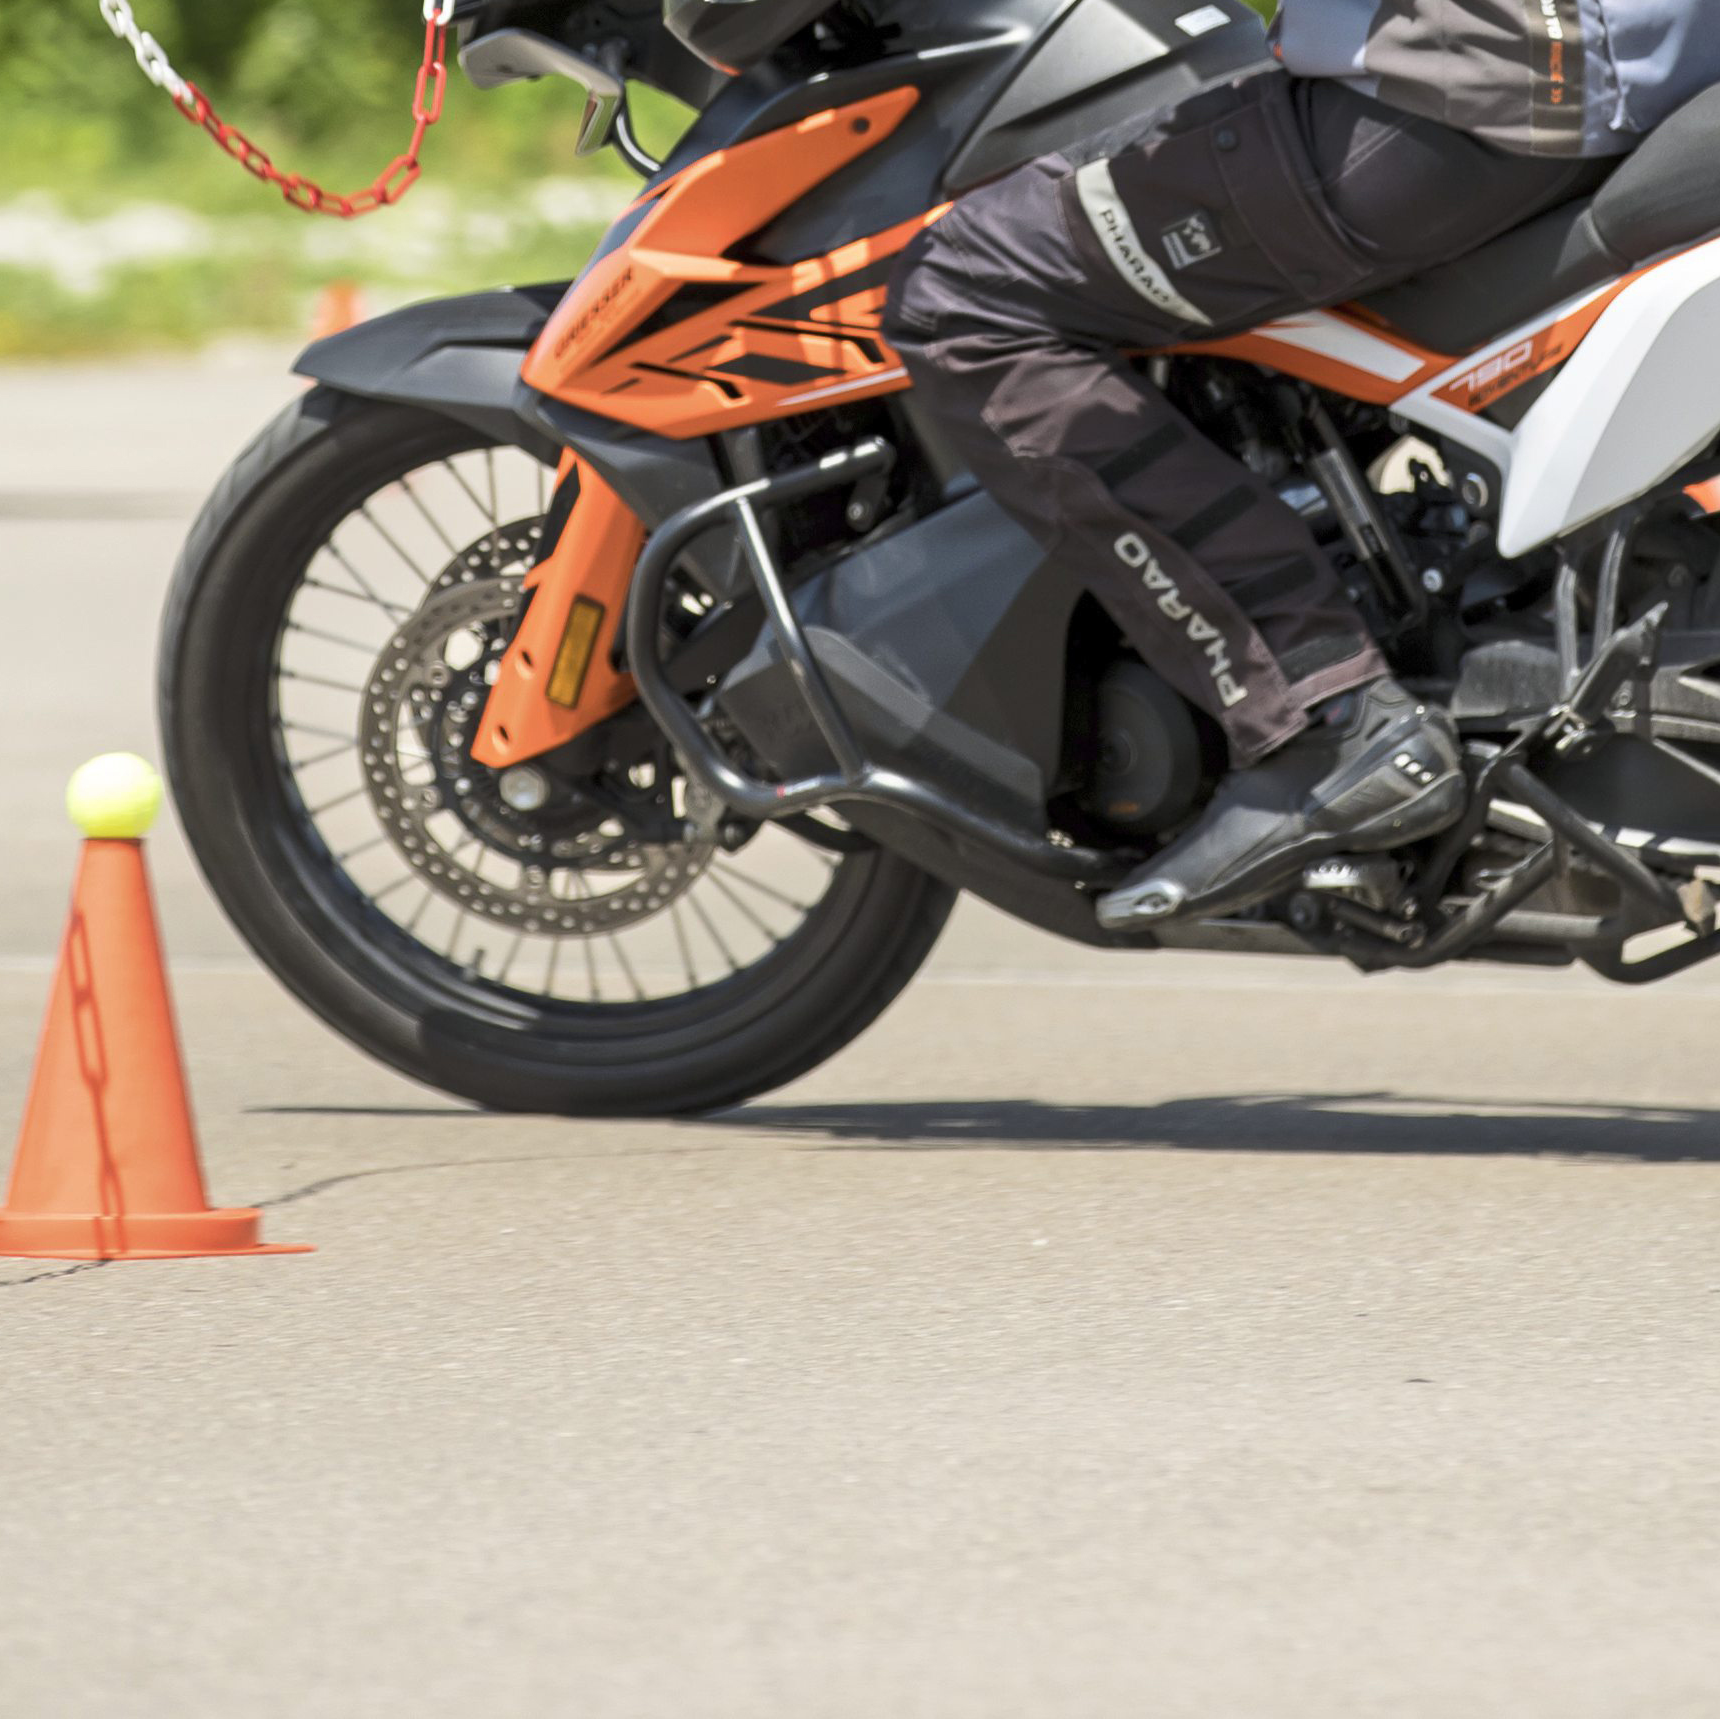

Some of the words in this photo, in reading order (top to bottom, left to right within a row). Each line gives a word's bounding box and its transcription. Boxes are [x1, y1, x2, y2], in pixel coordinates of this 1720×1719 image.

[1545, 16, 1563, 40] TO
[1448, 340, 1534, 393] 790
[1113, 532, 1248, 707] PHARAO
